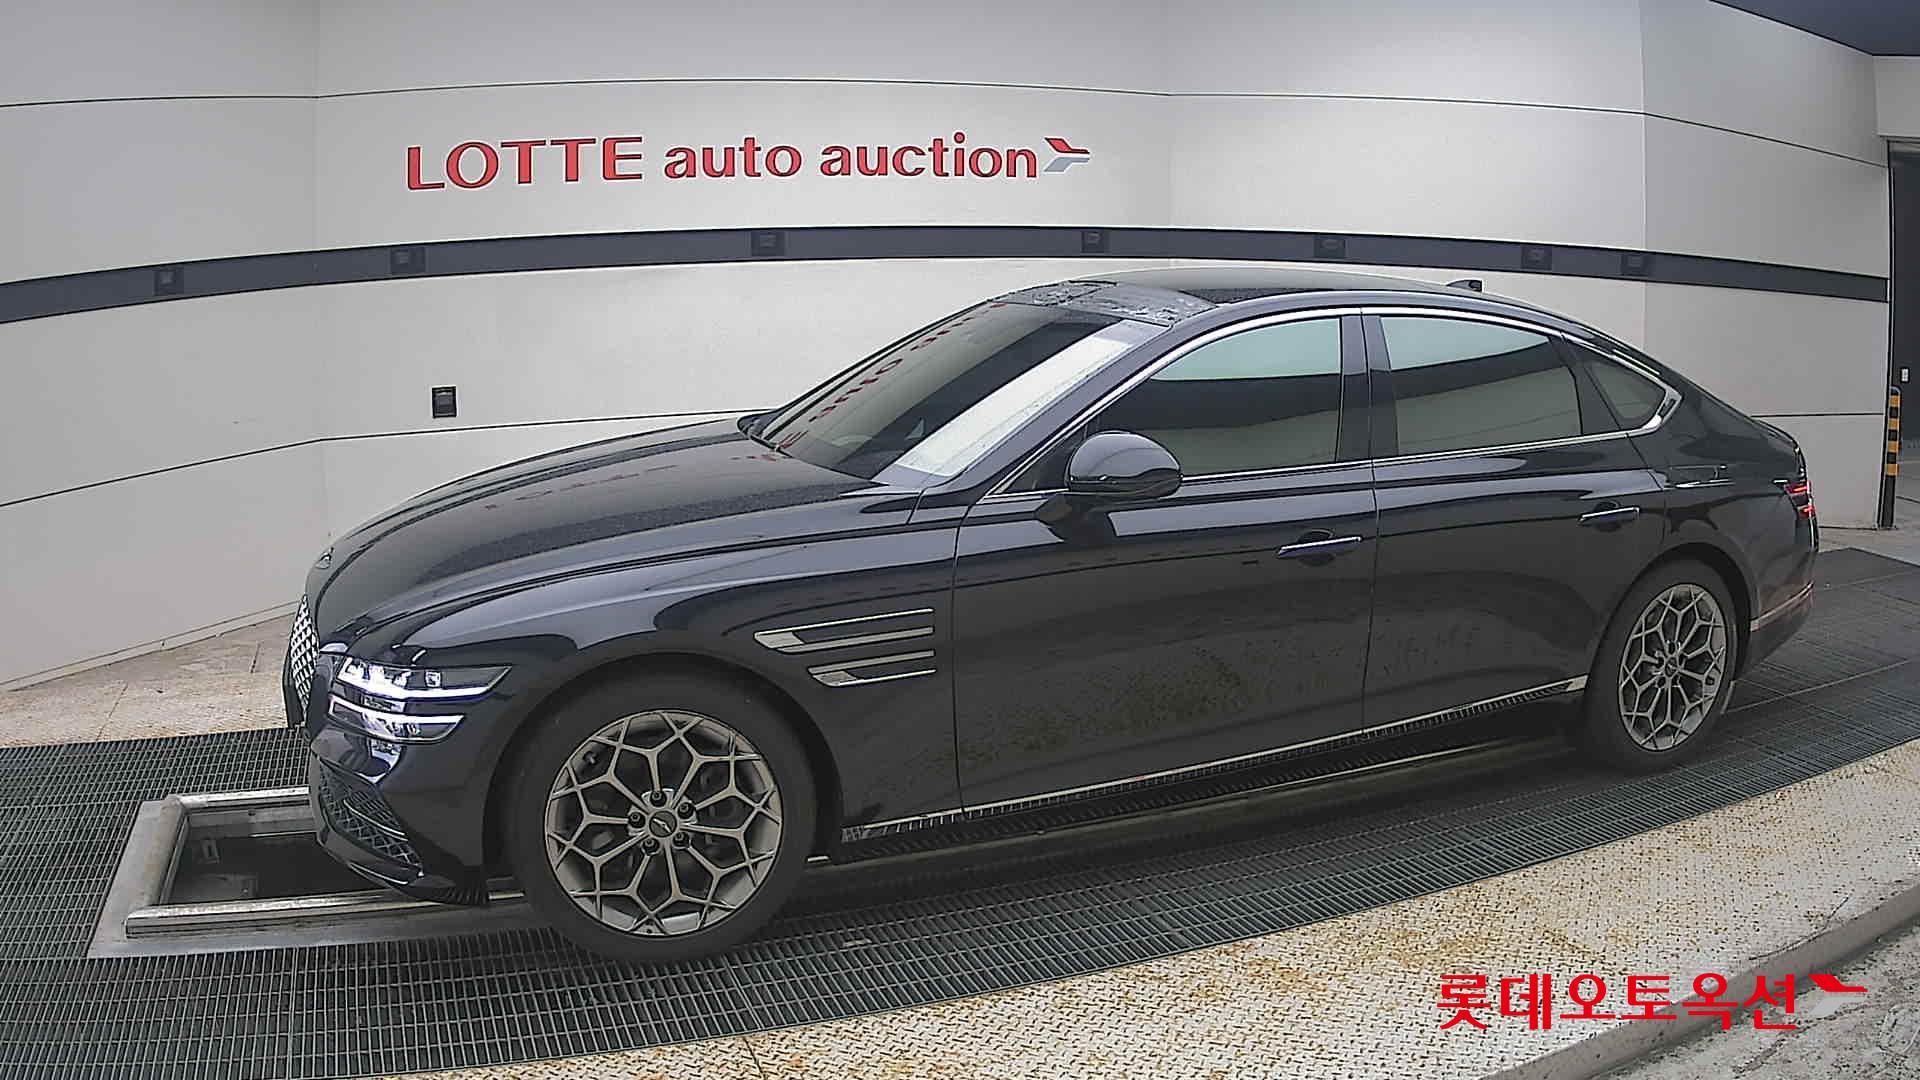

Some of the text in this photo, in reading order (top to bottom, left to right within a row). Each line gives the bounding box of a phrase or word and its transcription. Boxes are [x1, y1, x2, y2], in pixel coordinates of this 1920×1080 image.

[407, 132, 1038, 190] LOTTE auto auction
